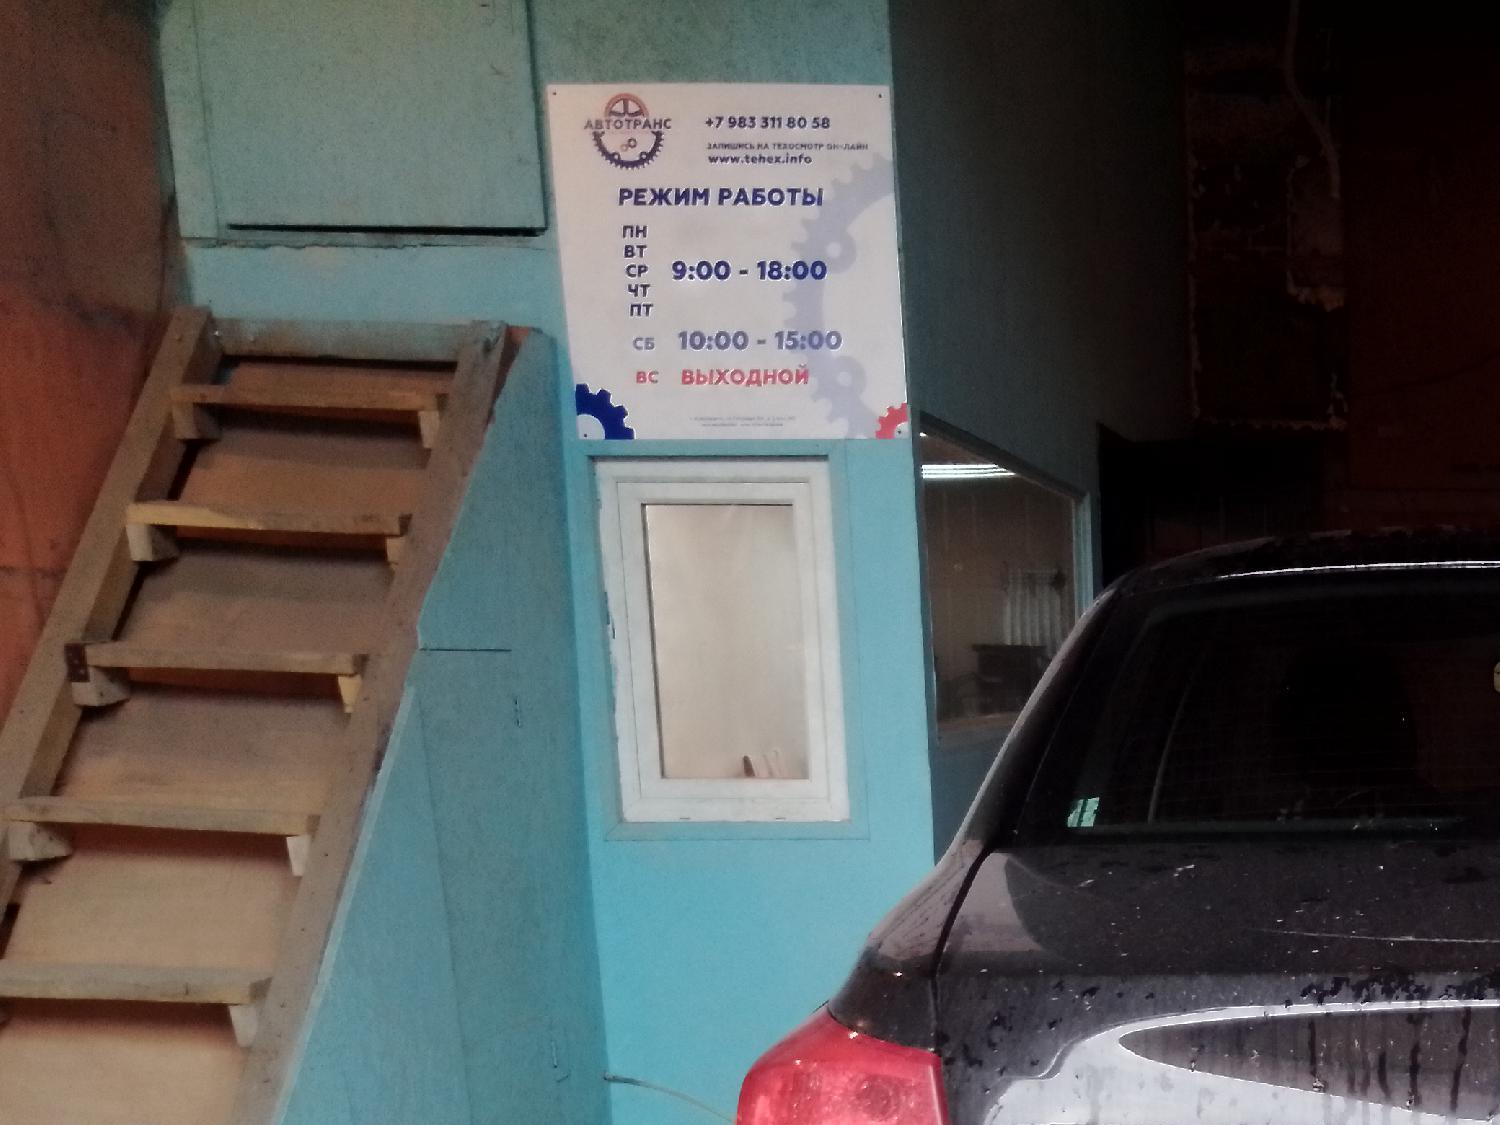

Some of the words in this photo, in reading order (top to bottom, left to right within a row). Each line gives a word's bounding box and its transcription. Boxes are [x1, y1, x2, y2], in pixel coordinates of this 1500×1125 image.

[584, 117, 672, 130] АВТОТРАНС
[705, 116, 722, 129] +7
[728, 116, 756, 129] 983
[760, 116, 783, 129] 311
[786, 116, 808, 129] 80
[812, 116, 831, 129] 58
[708, 152, 812, 164] www.tehex.info
[618, 187, 710, 206] РЕЖИМ
[717, 187, 824, 206] РАБОТЫ
[622, 225, 648, 239] ПН
[624, 245, 647, 258] ВТ
[625, 264, 649, 278] СР
[671, 261, 731, 281] 9:00
[757, 260, 827, 280] 18:00
[628, 284, 650, 297] ЧТ
[629, 303, 653, 317] ПТ
[633, 337, 655, 350] СБ
[678, 330, 749, 350] 10:00
[775, 330, 843, 350] 15:00
[636, 371, 659, 384] ВС
[681, 363, 809, 386] ВЫХОДНОЙ
